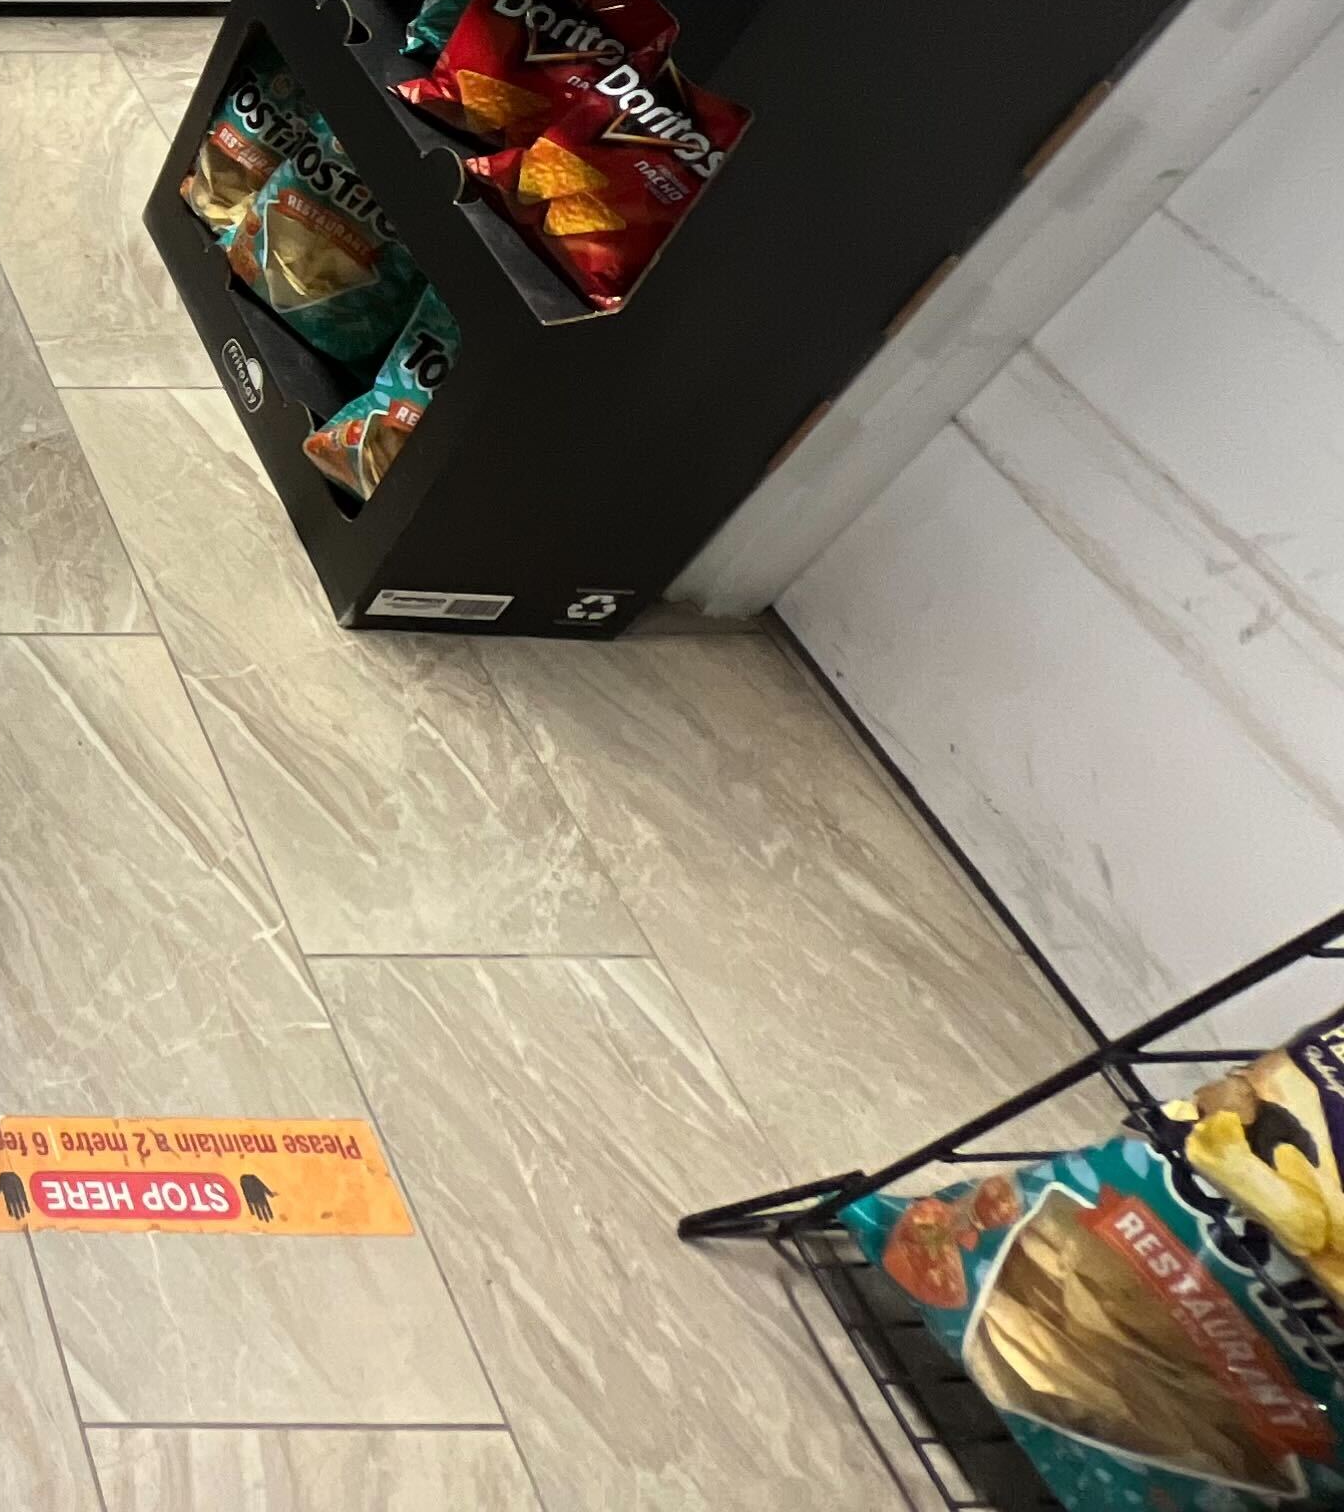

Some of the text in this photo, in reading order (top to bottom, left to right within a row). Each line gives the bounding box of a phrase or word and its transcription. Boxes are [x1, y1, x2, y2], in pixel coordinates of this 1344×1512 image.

[594, 64, 727, 178] Doritos
[31, 1130, 49, 1157] 6
[60, 1130, 130, 1155] metre
[132, 1131, 149, 1158] 2
[178, 1133, 280, 1159] maintain
[46, 1179, 232, 1216] STOP HERE
[1112, 1211, 1310, 1432] RESTAURANT
